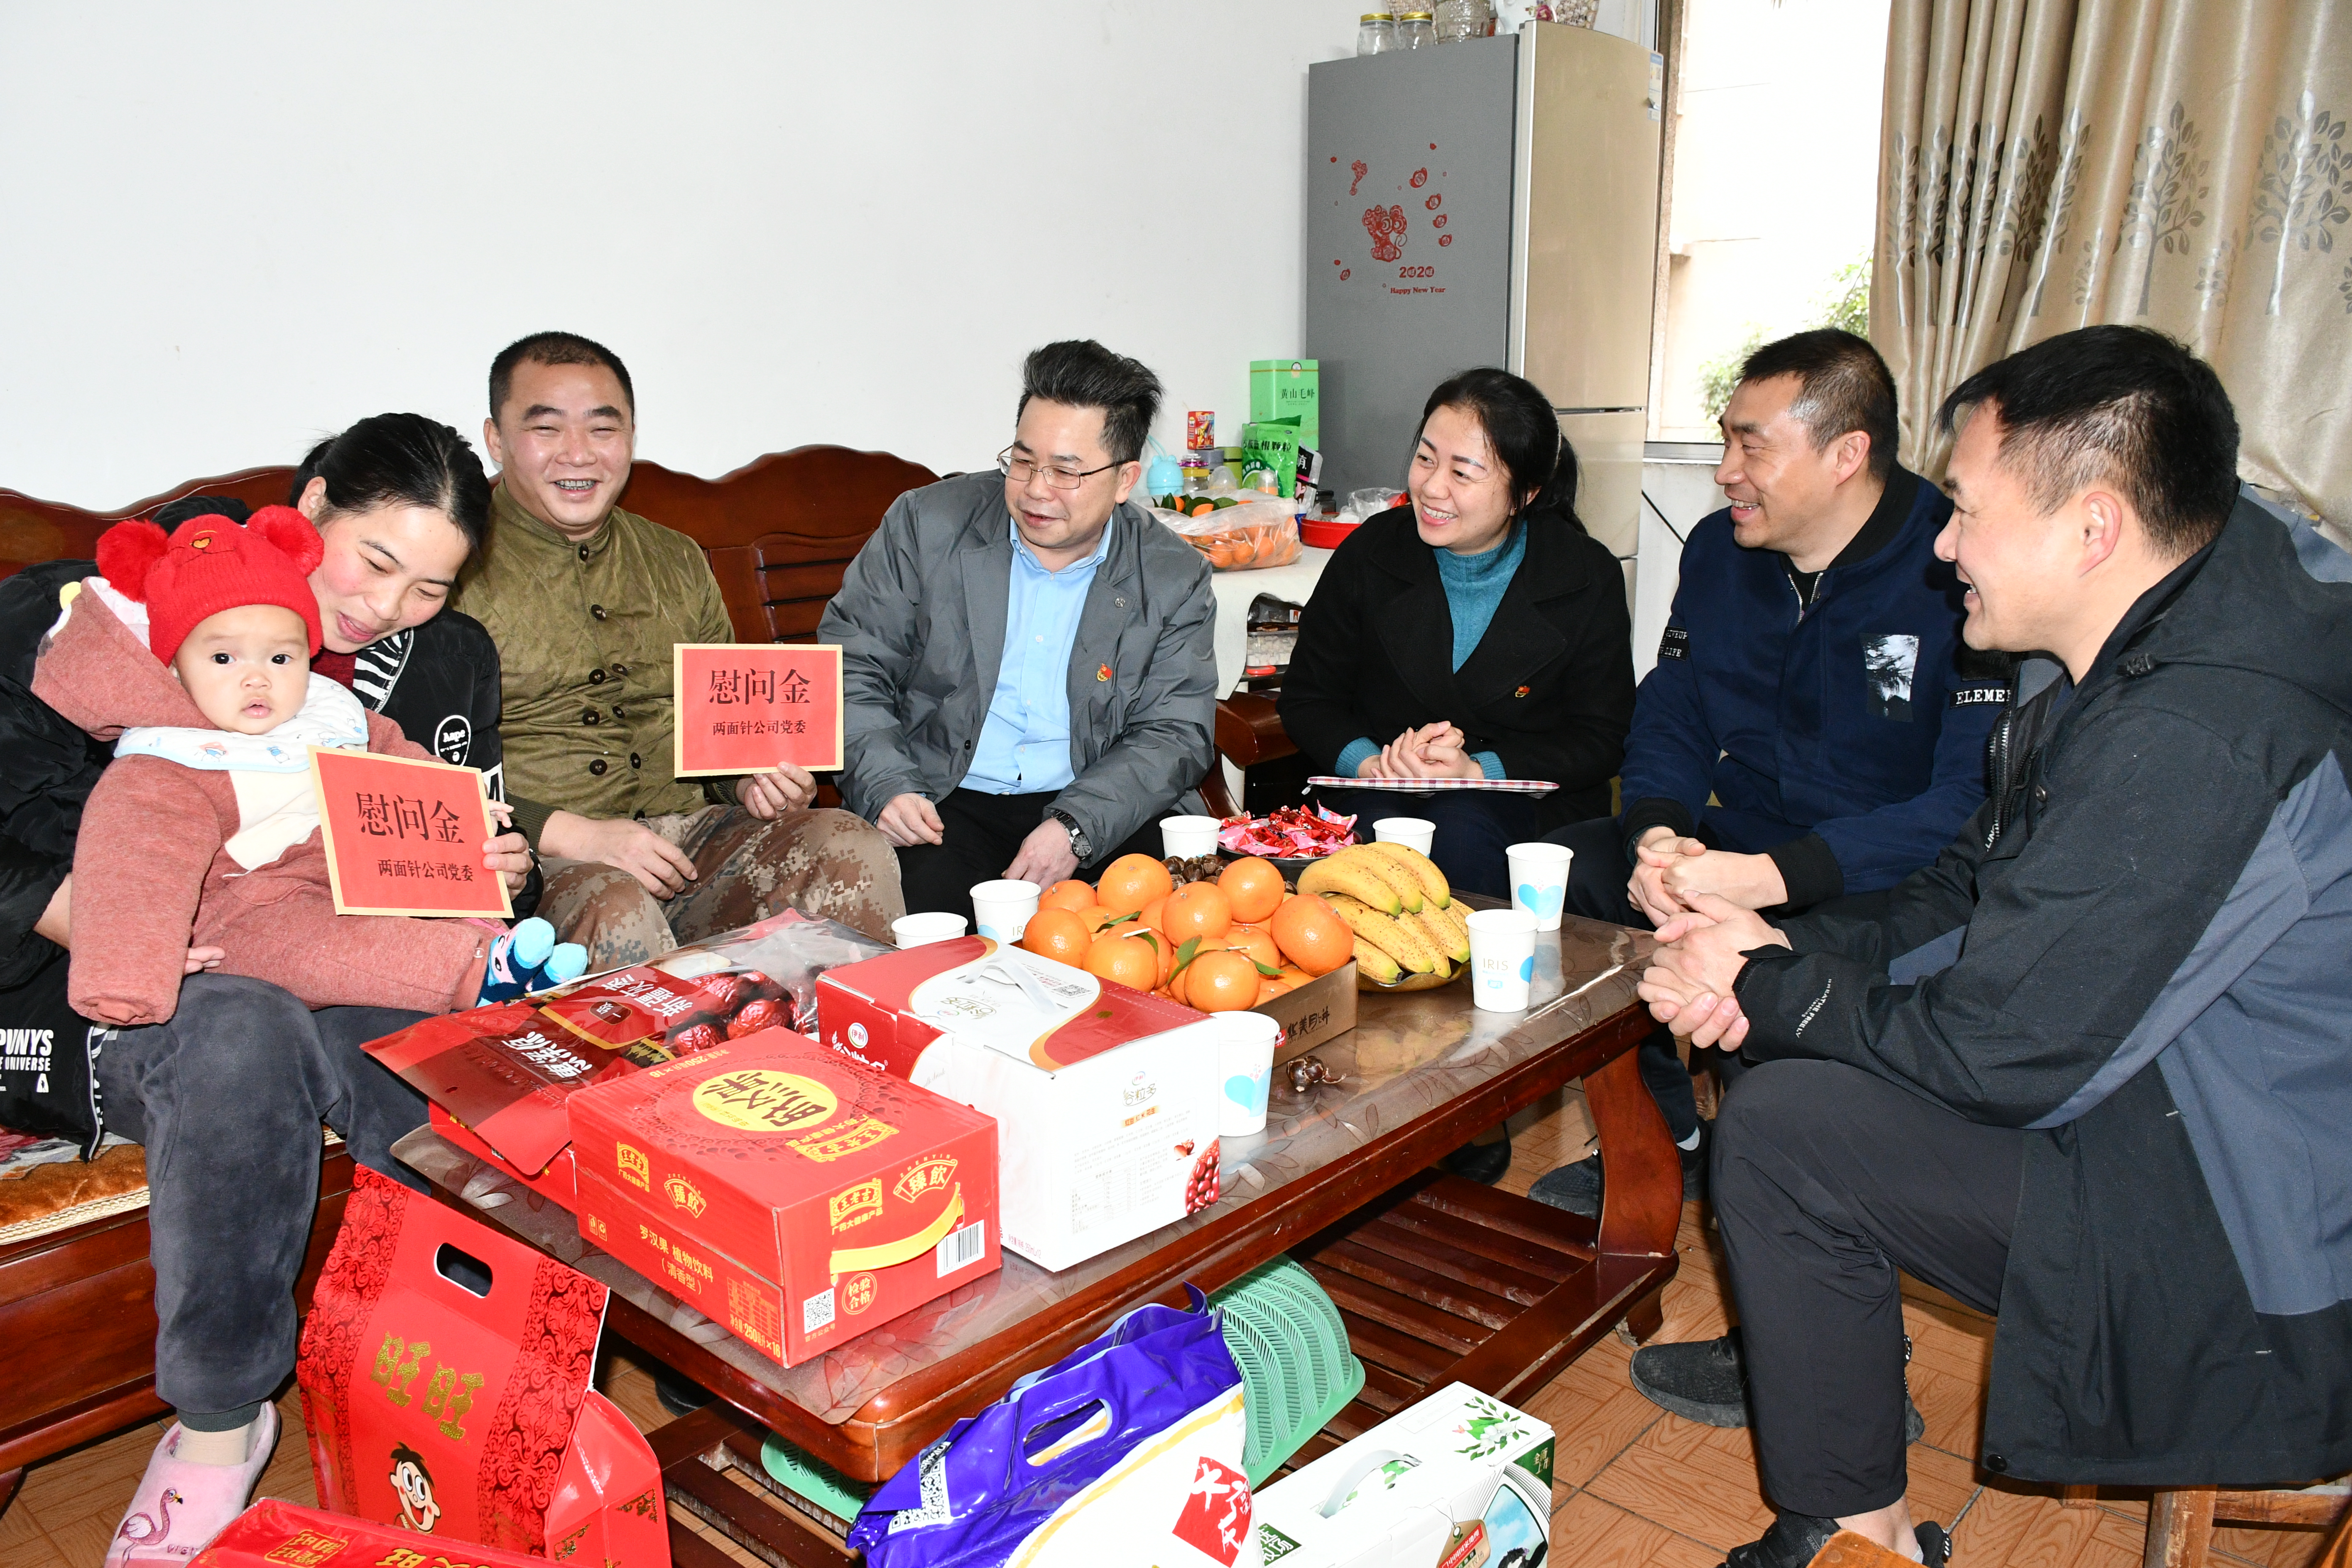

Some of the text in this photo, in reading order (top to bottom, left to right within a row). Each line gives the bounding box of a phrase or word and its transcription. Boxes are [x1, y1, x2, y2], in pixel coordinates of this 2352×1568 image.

[1399, 266, 1435, 278] 2020
[1281, 388, 1315, 399] 黄山毛峰
[708, 668, 811, 705] 慰问金
[443, 730, 466, 743] Aape
[713, 720, 806, 736] 两面针公司党委
[356, 792, 466, 844] 慰问金
[378, 860, 474, 883] 两面针公司党委
[1484, 958, 1508, 971] IRIS
[601, 974, 693, 1018] 新疆灰枣
[597, 1002, 621, 1018] 一级
[1288, 1006, 1330, 1040] 华美月饼
[851, 1029, 864, 1042] 伊利
[5, 1056, 51, 1071] UNIVERSE
[701, 1072, 828, 1127] 罗汉果
[1124, 1083, 1157, 1105] 谷粒多
[828, 1130, 877, 1155] 王老吉
[623, 1150, 642, 1168] 王老吉
[900, 1154, 951, 1178] ZHENYIN
[840, 1188, 871, 1210] 王老吉
[831, 1207, 883, 1235] 广药大健康产品
[640, 1224, 713, 1282] 罗汉果 植物饮料
[848, 1277, 870, 1298] 检验
[849, 1290, 871, 1309] 合格
[805, 1323, 836, 1342] 官方公众号
[369, 1331, 485, 1441] 旺旺
